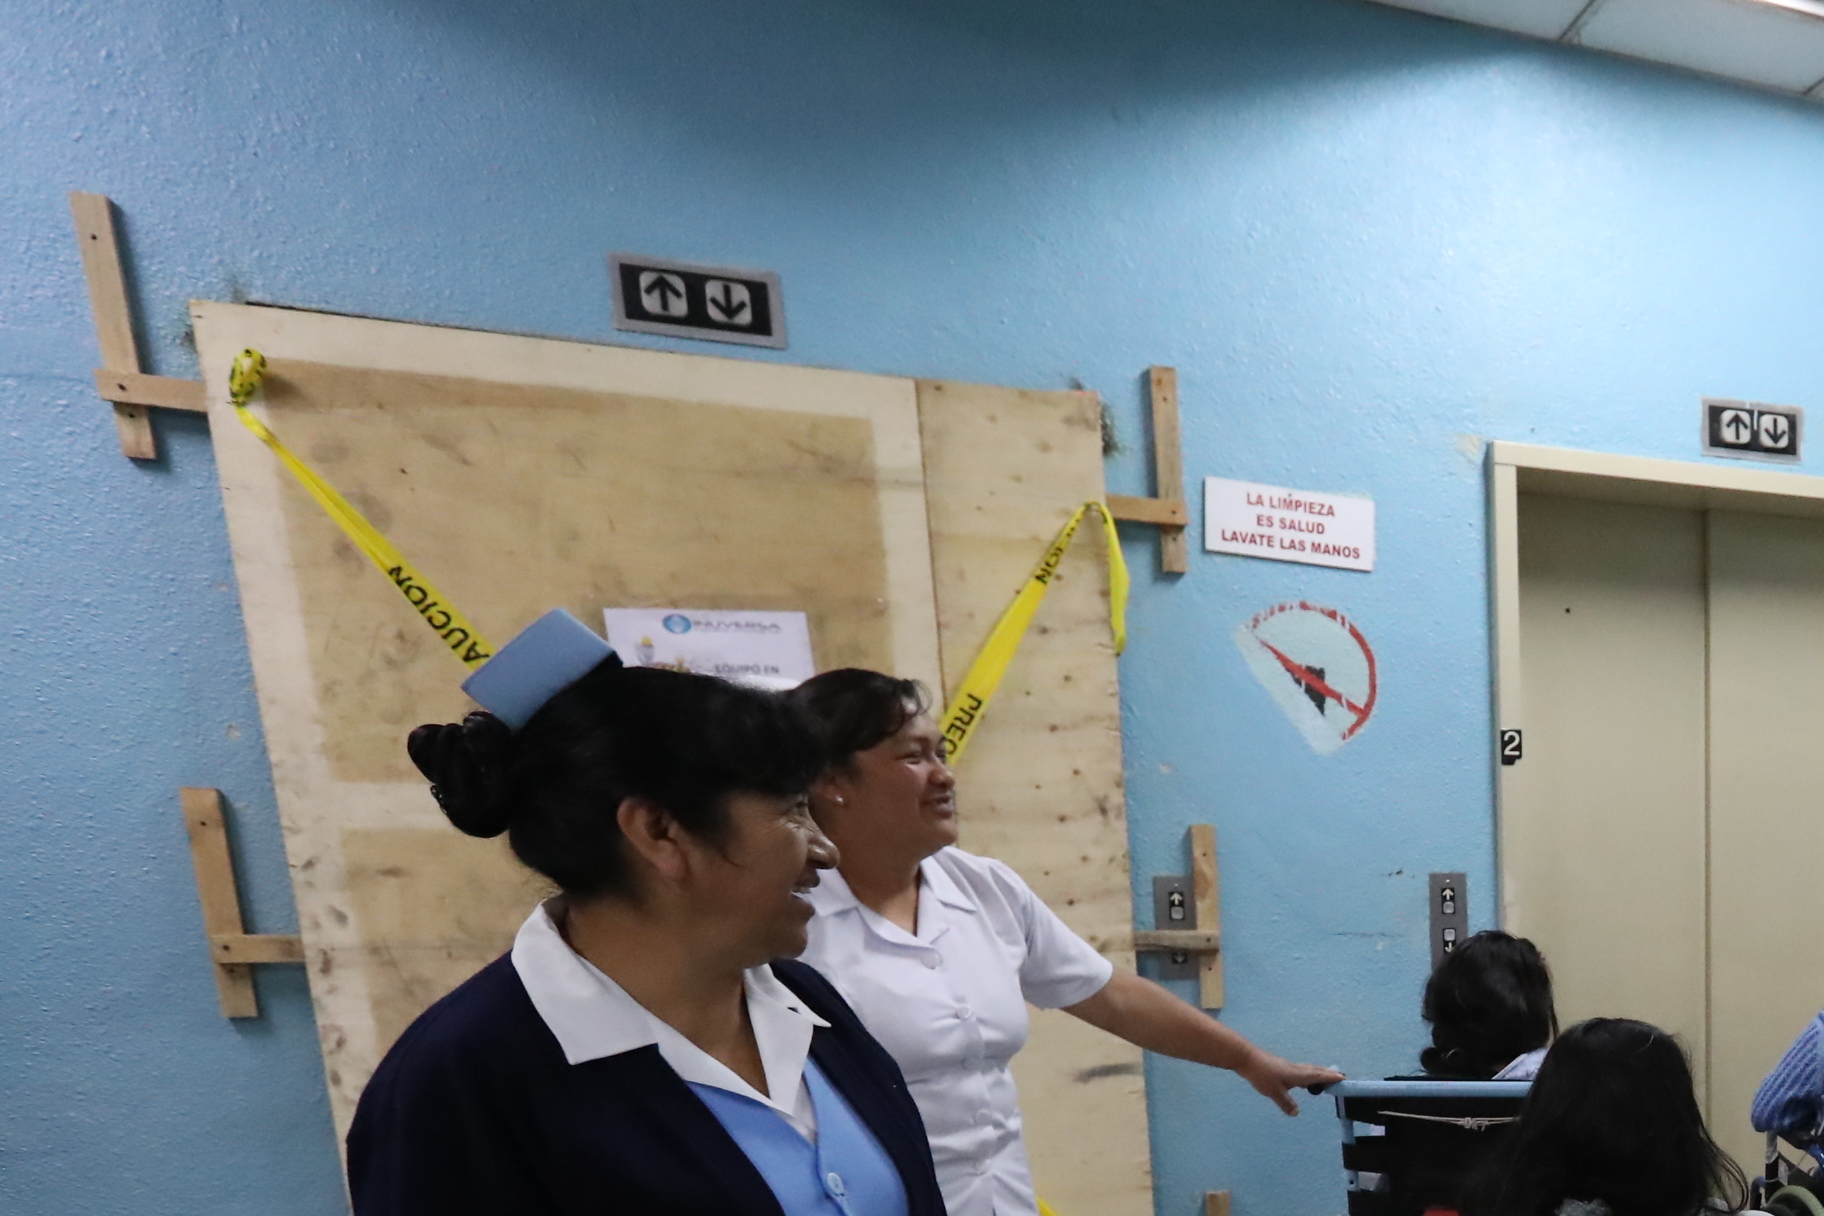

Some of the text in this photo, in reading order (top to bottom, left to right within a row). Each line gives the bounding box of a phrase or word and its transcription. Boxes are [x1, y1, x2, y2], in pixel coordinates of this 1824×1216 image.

[1246, 492, 1335, 517] LA LIMPIEZA
[1256, 514, 1325, 534] ES SALUD
[1221, 529, 1360, 560] LAVATE LAS MANOS
[1503, 730, 1520, 756] 2
